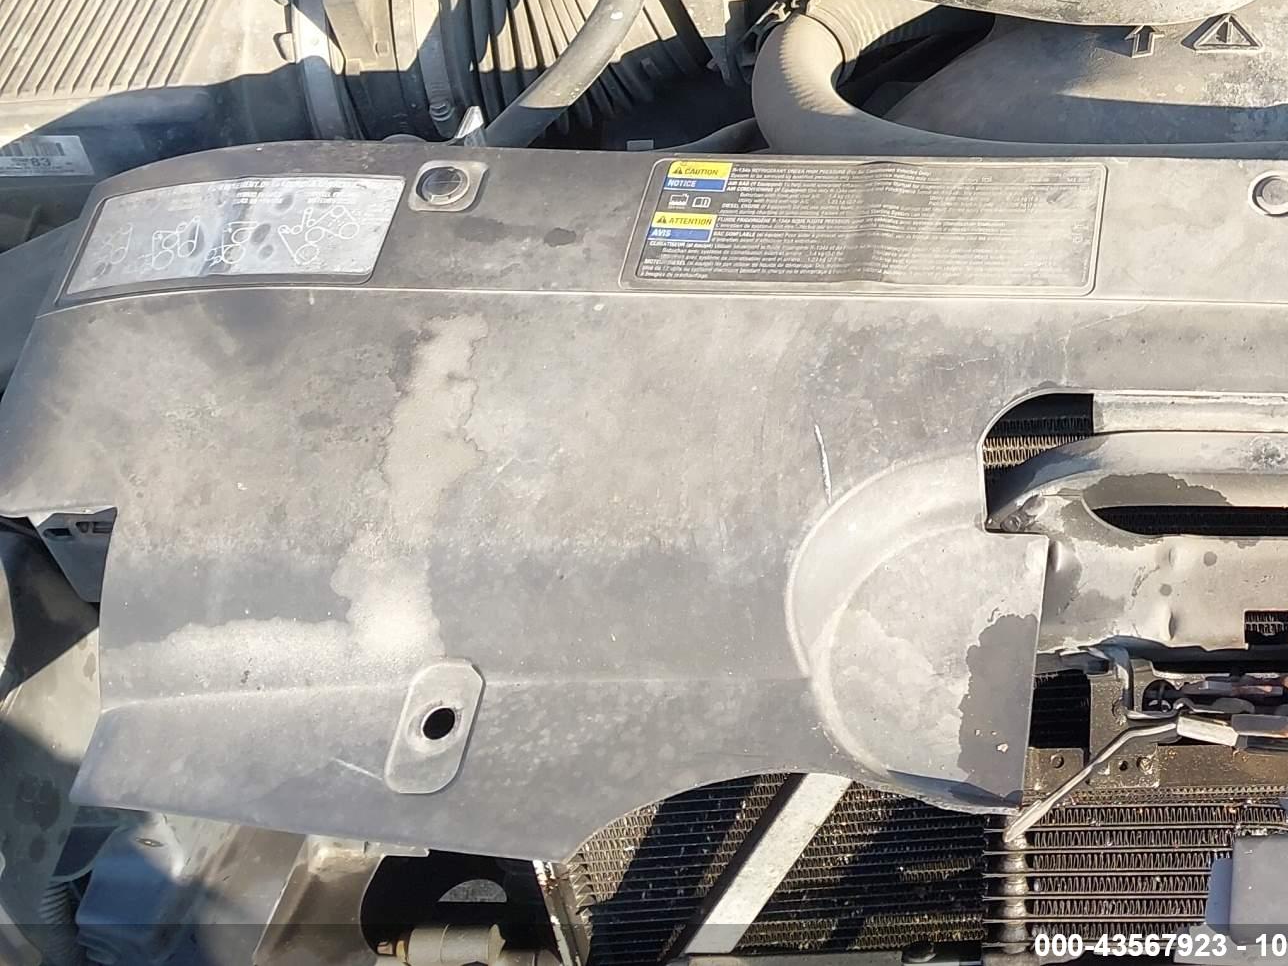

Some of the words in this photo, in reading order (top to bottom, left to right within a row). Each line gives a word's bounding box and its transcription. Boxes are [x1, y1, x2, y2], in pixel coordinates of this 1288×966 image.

[684, 168, 719, 176] CAUTION
[667, 180, 697, 188] NOTICE
[668, 217, 712, 226] ATTENTION
[652, 229, 671, 237] AVIS
